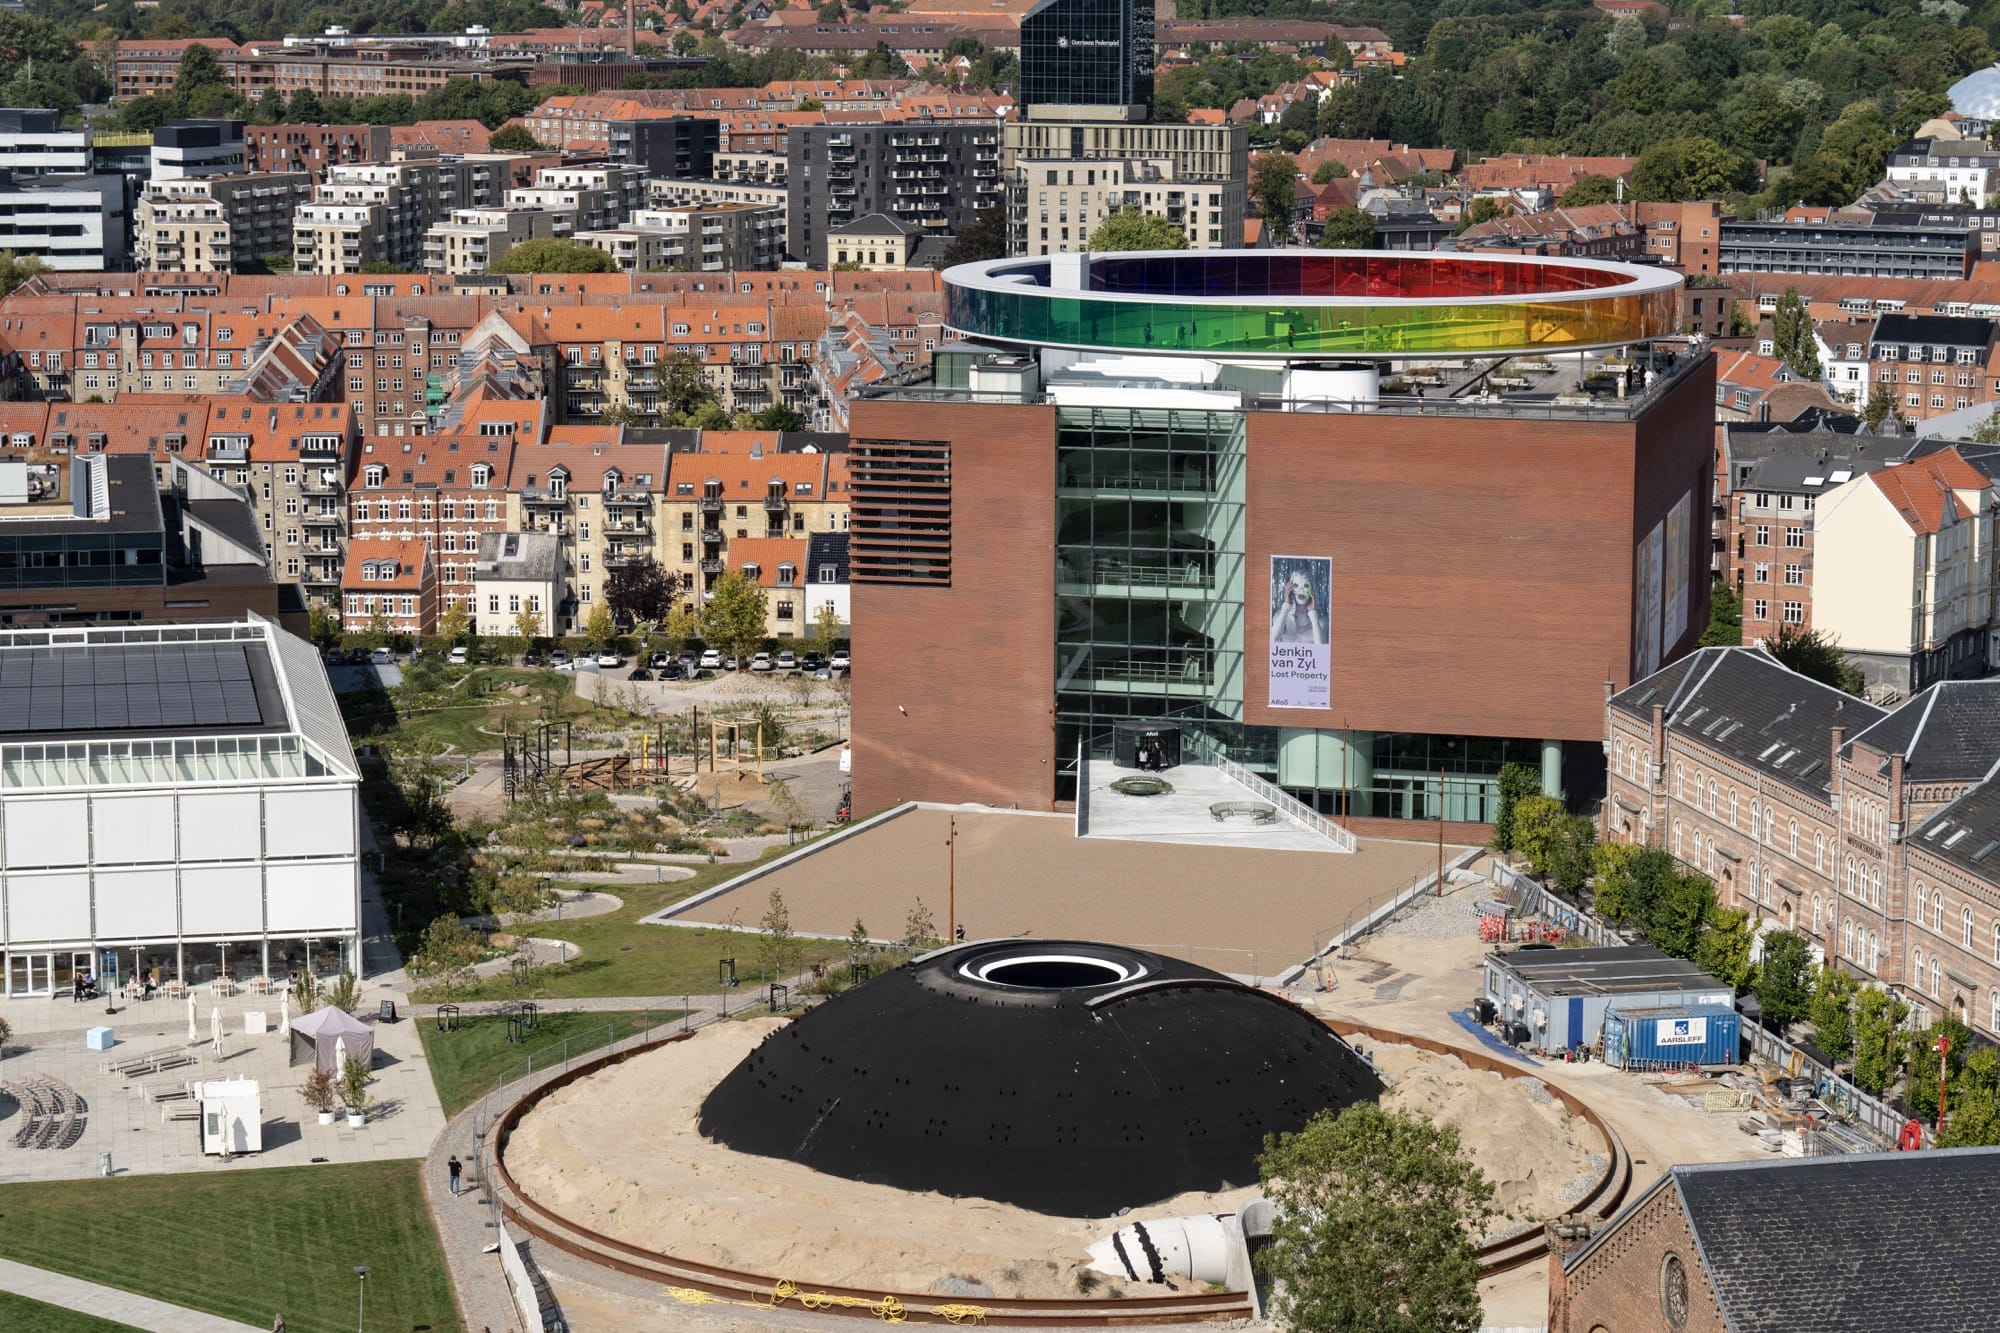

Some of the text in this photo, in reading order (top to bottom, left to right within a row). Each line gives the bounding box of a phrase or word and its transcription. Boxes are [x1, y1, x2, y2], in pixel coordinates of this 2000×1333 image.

[1271, 645, 1313, 658] Jenkin
[1271, 657, 1317, 671] van Zyl
[1271, 670, 1328, 681] Lost Property
[1847, 835, 1882, 860] MUSIKSKOLEN
[1660, 1035, 1703, 1044] AARSLEFF
